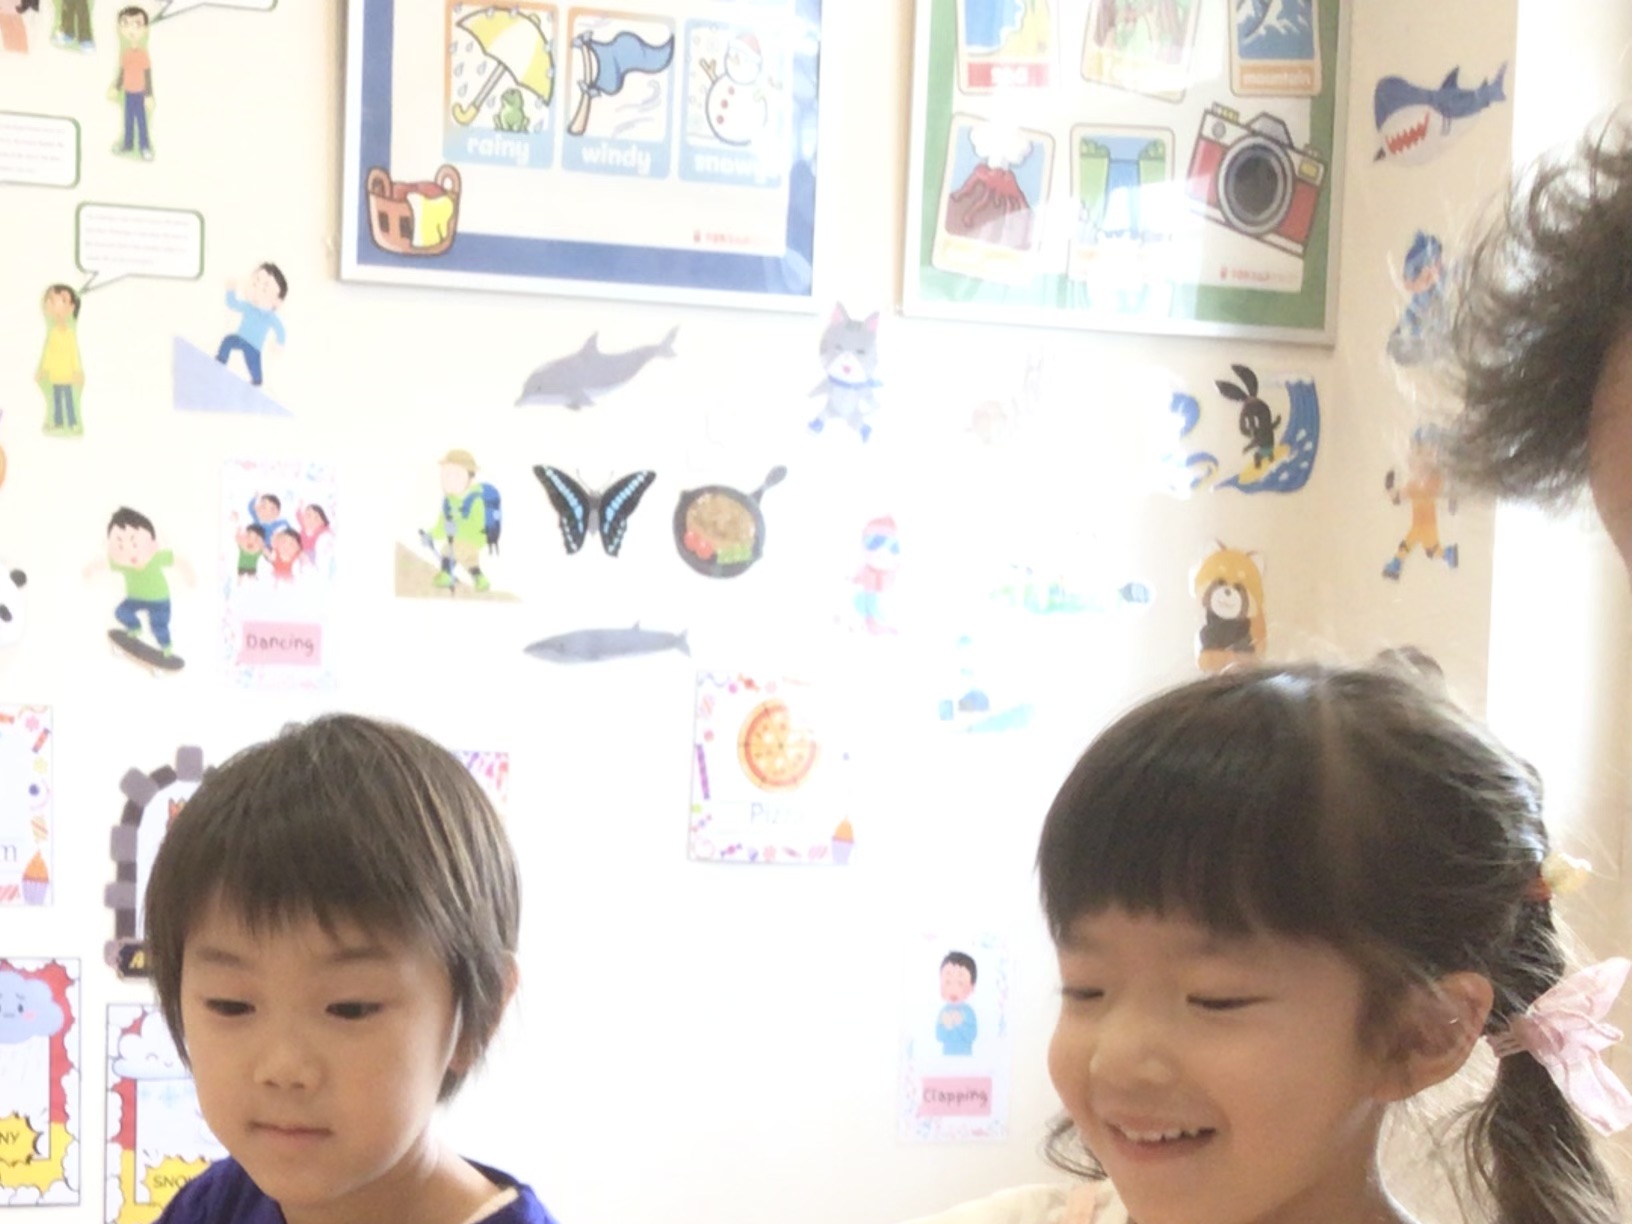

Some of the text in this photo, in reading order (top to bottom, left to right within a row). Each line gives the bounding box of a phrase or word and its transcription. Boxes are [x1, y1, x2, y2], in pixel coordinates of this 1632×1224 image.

[468, 133, 530, 165] rainy
[581, 141, 652, 175] windy
[245, 633, 315, 656] Dancing
[921, 1084, 990, 1108] Clapping
